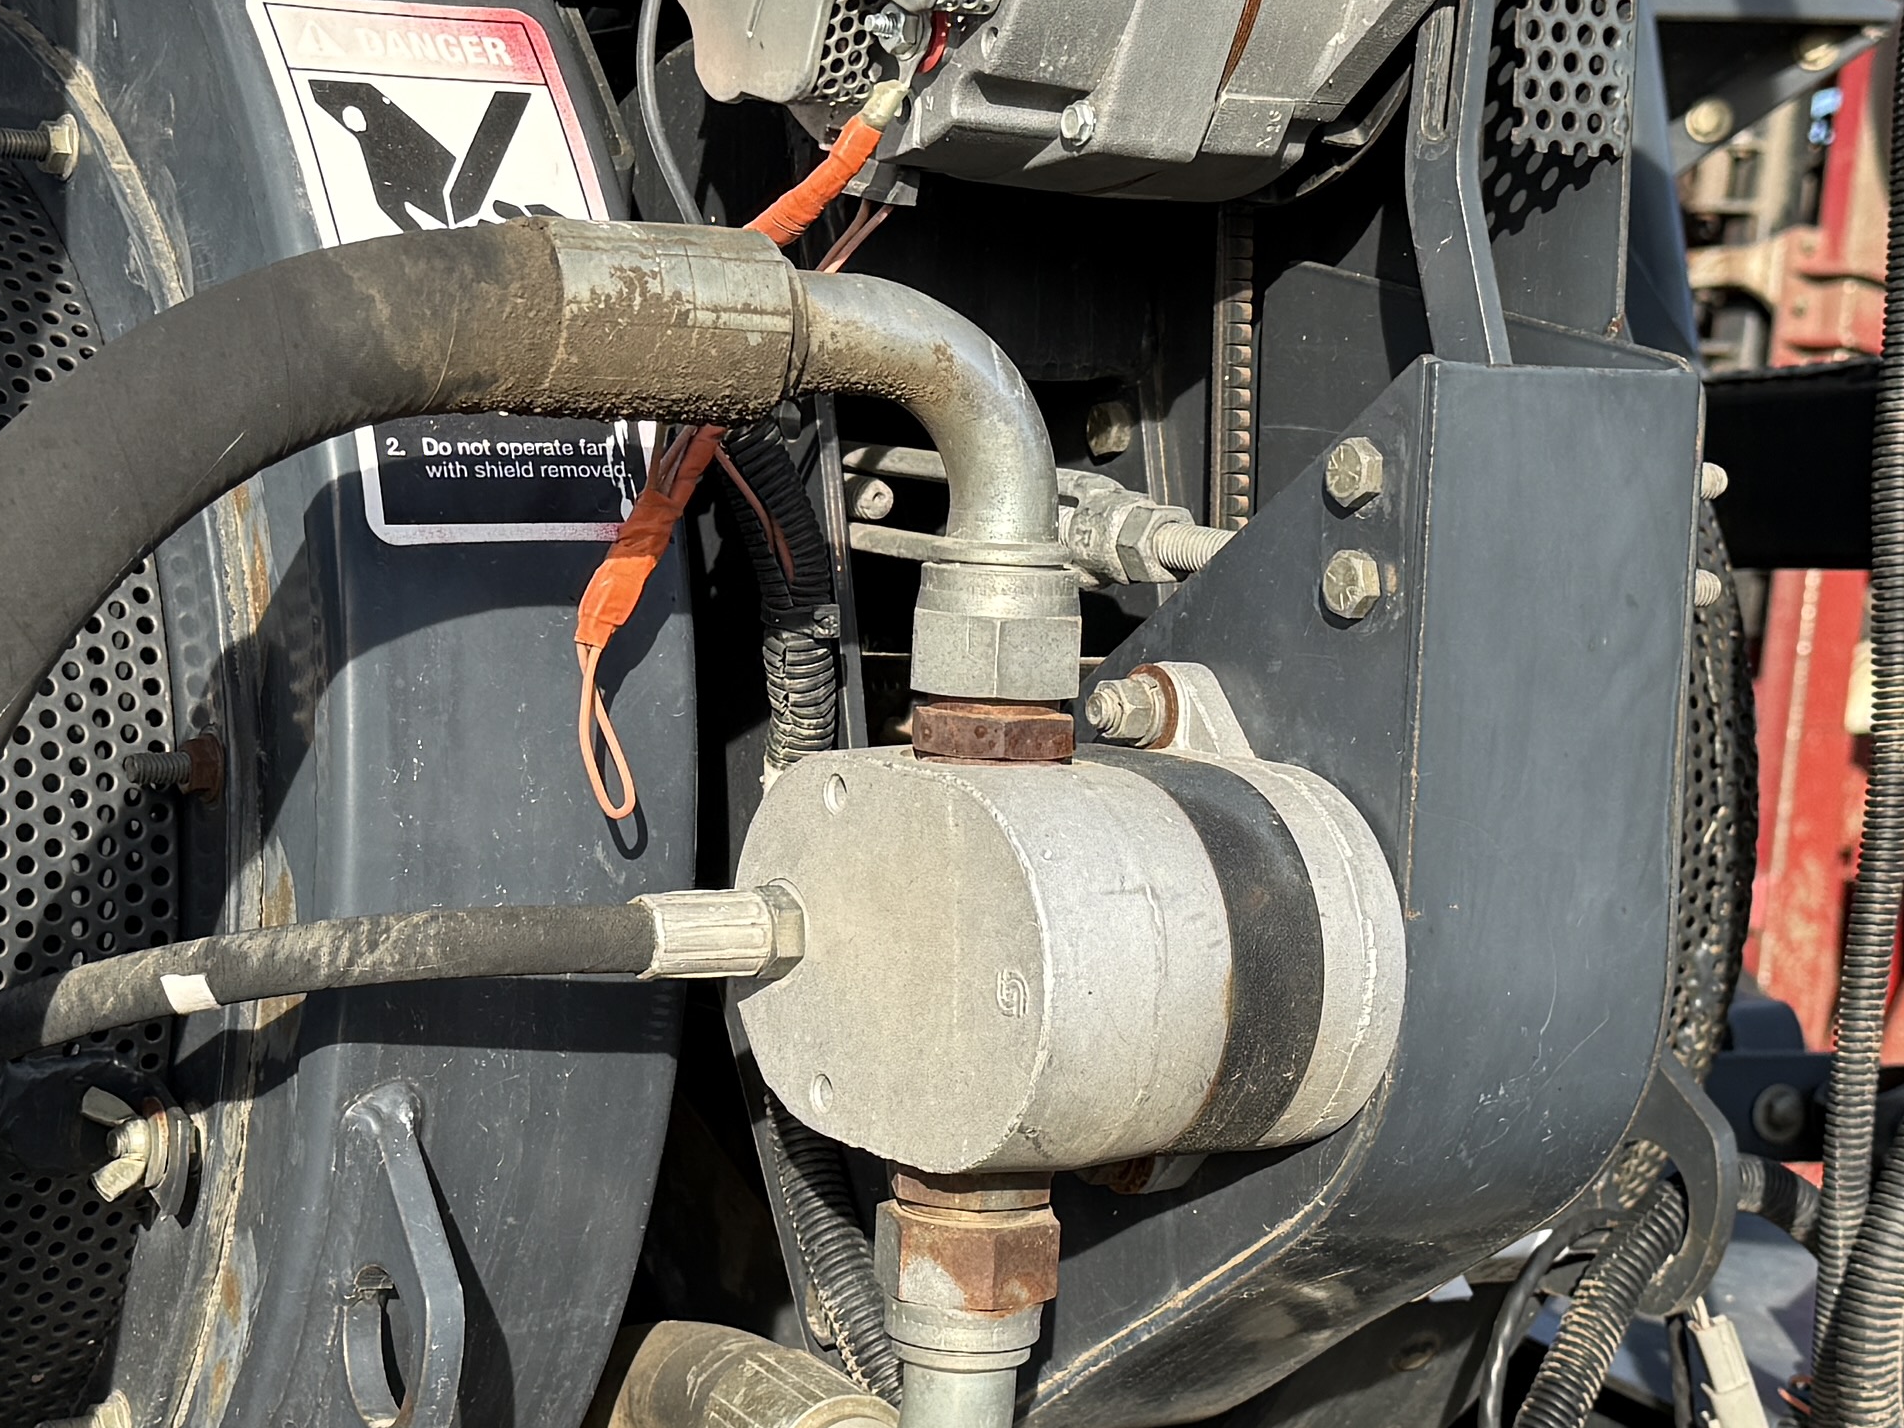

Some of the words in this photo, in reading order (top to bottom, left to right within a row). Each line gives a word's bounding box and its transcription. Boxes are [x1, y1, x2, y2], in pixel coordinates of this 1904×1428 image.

[354, 27, 514, 67] DANGER
[385, 437, 407, 457] 2.
[421, 437, 453, 457] Do
[456, 438, 492, 457] not
[496, 439, 574, 460] operate
[579, 438, 614, 457] fan
[425, 460, 469, 478] with
[474, 460, 535, 478] shield
[540, 461, 633, 479] removed.
